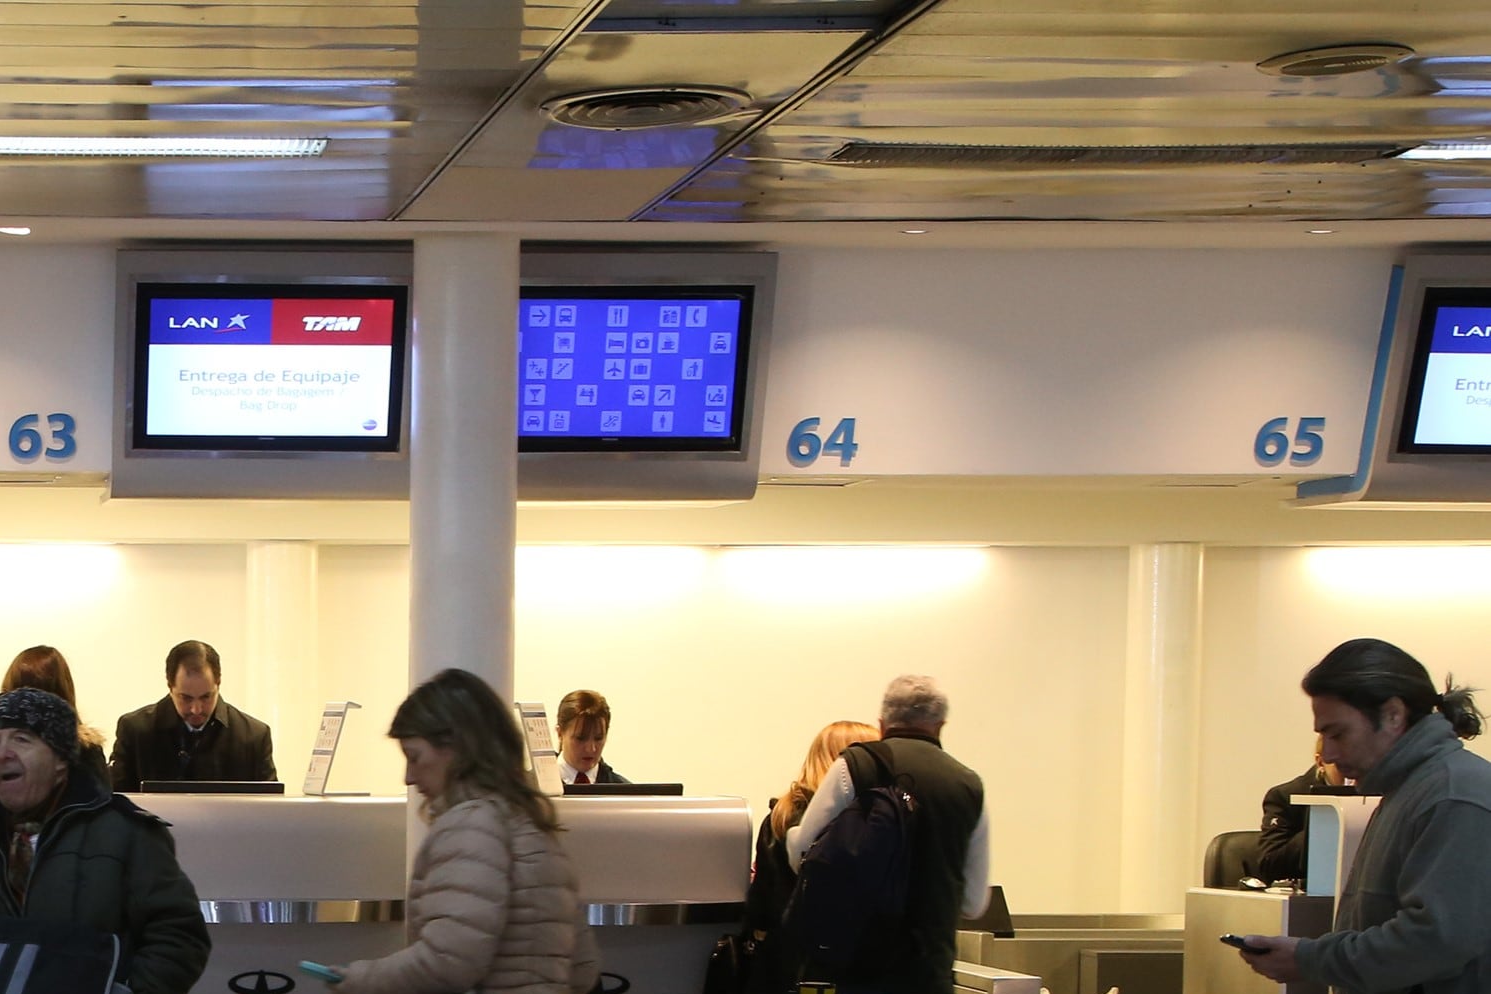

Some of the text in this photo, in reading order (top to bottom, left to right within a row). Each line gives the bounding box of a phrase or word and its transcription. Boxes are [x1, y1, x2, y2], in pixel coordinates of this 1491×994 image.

[168, 316, 362, 332] LAN TAM
[178, 369, 361, 384] Entrega de Equipaje
[9, 413, 76, 459] 63
[786, 416, 858, 466] 64
[1254, 417, 1325, 465] 65
